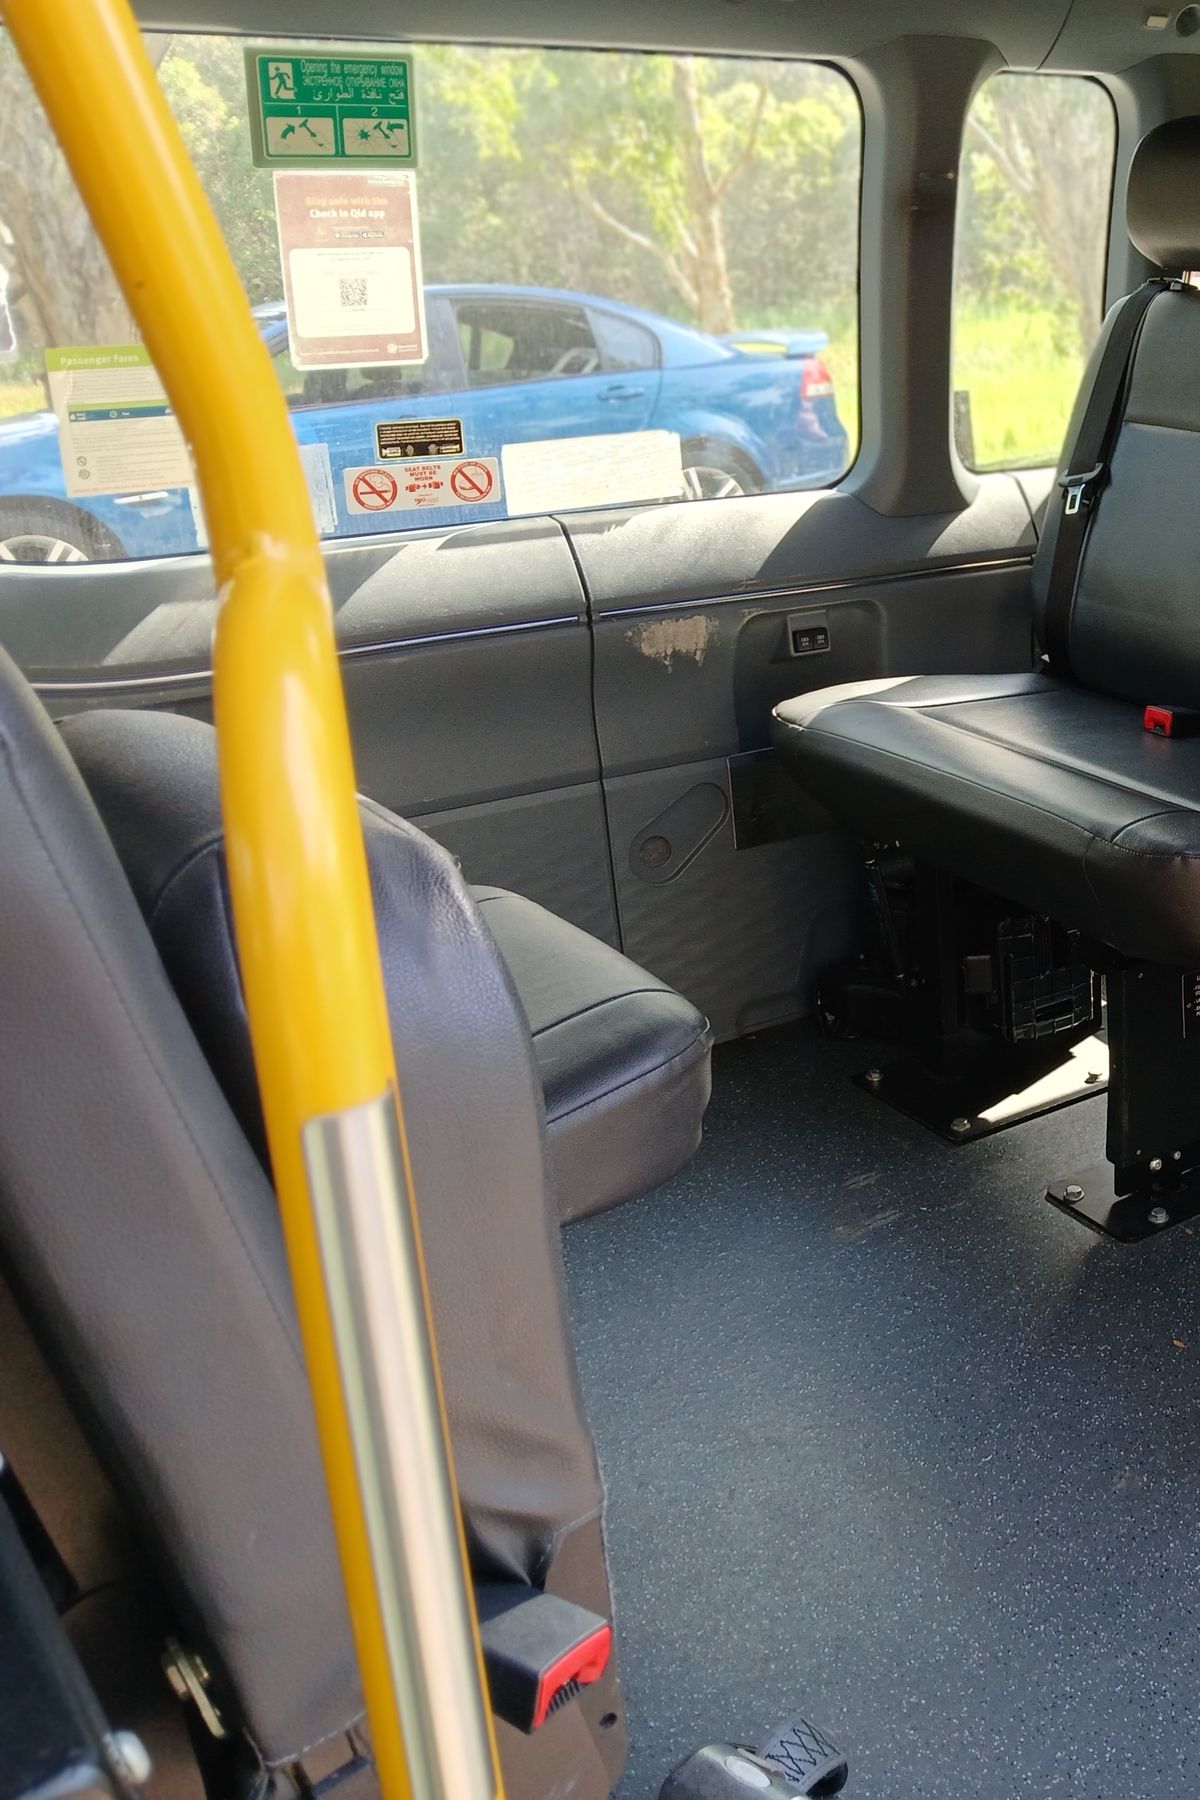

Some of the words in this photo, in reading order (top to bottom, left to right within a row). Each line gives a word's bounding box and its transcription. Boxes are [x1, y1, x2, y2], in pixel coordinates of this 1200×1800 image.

[300, 60, 328, 76] Opening
[330, 62, 341, 73] the
[343, 62, 377, 76] emergency
[381, 62, 403, 75] window
[296, 106, 301, 114] 1
[371, 107, 378, 116] 2
[309, 208, 338, 218] Check
